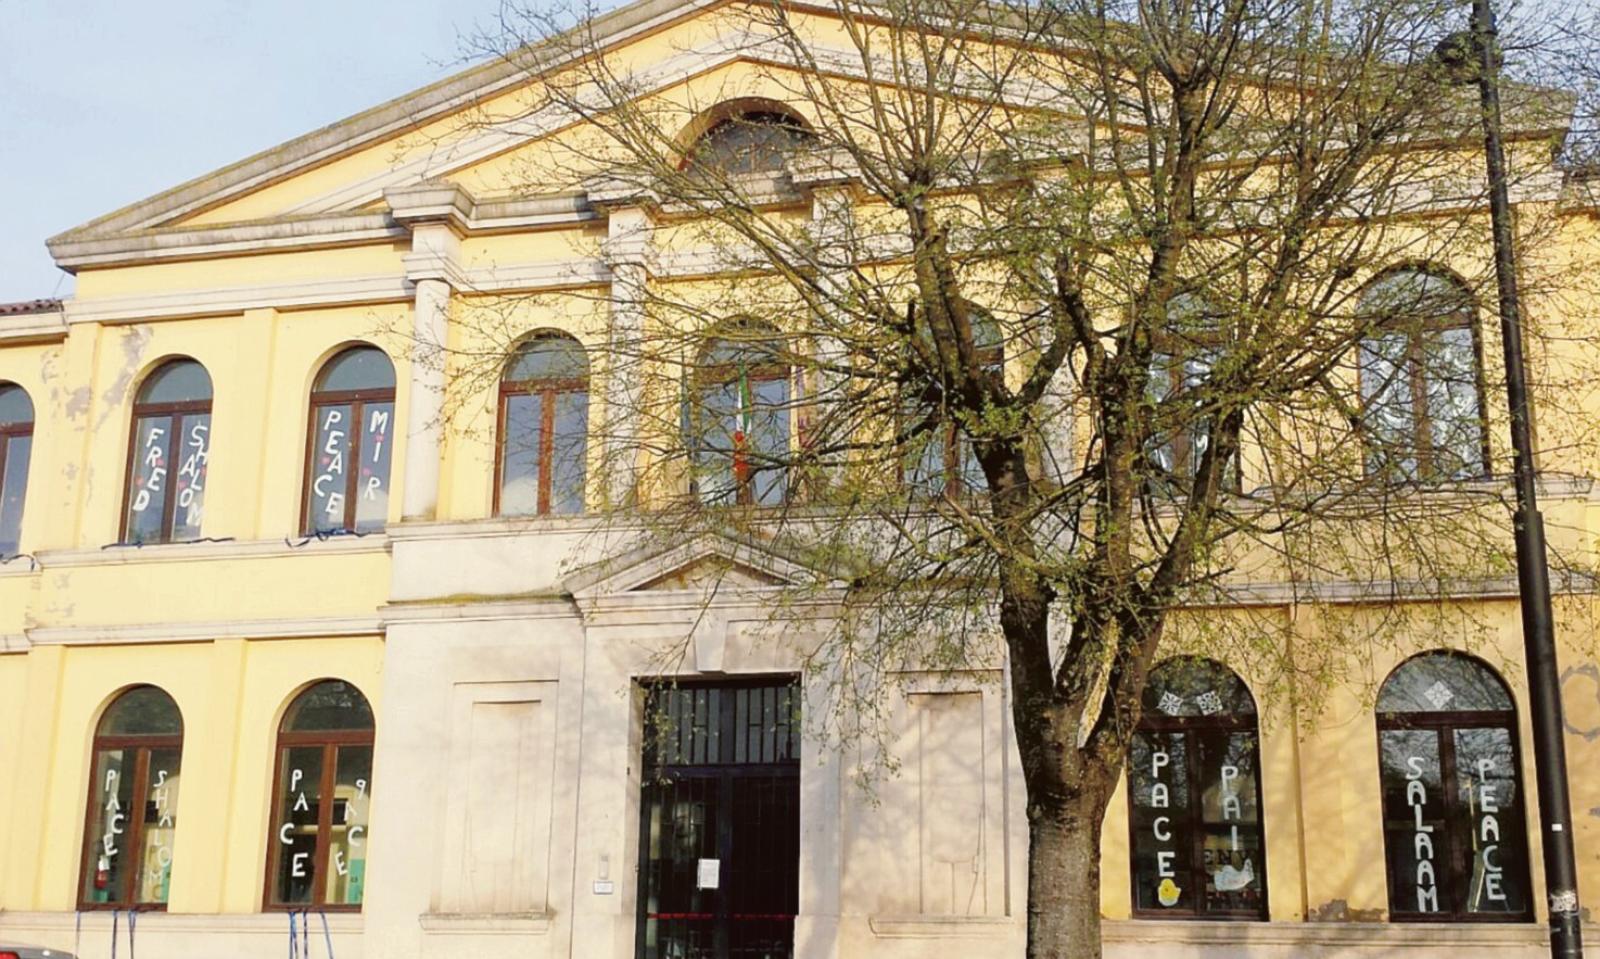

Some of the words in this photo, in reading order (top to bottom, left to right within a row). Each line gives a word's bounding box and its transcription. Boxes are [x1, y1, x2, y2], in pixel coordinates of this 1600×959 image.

[133, 428, 167, 511] FRED
[180, 422, 208, 526] SHALOM
[314, 410, 344, 514] PEACE
[364, 410, 388, 500] MIR
[104, 769, 124, 856] PACE
[150, 769, 172, 884] SHALOM
[280, 769, 308, 877] PACE
[1151, 752, 1176, 877] PACE
[1405, 757, 1439, 912] SALAAM
[1477, 759, 1506, 900] PEACE
